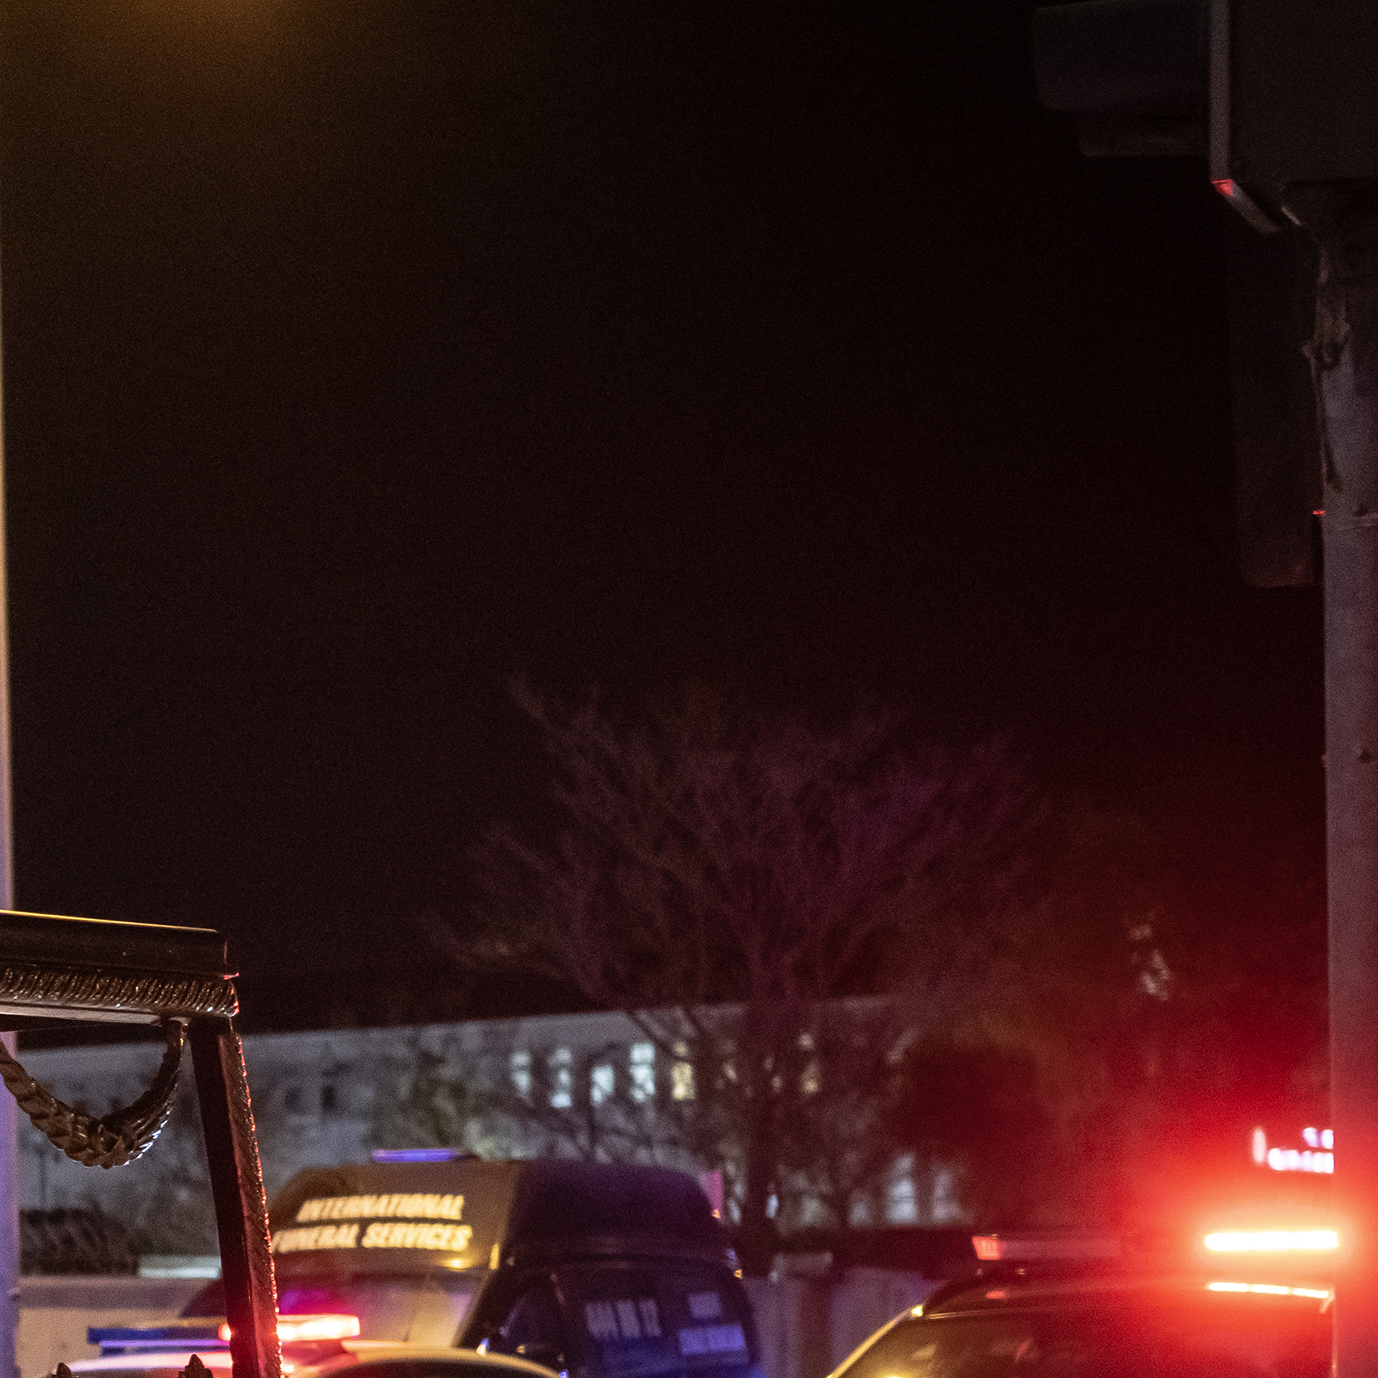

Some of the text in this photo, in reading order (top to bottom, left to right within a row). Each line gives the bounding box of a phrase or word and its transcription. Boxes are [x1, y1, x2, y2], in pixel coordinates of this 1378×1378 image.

[296, 1193, 464, 1223] INTERNATIONAL
[272, 1222, 472, 1254] FUNERAL SERVICES
